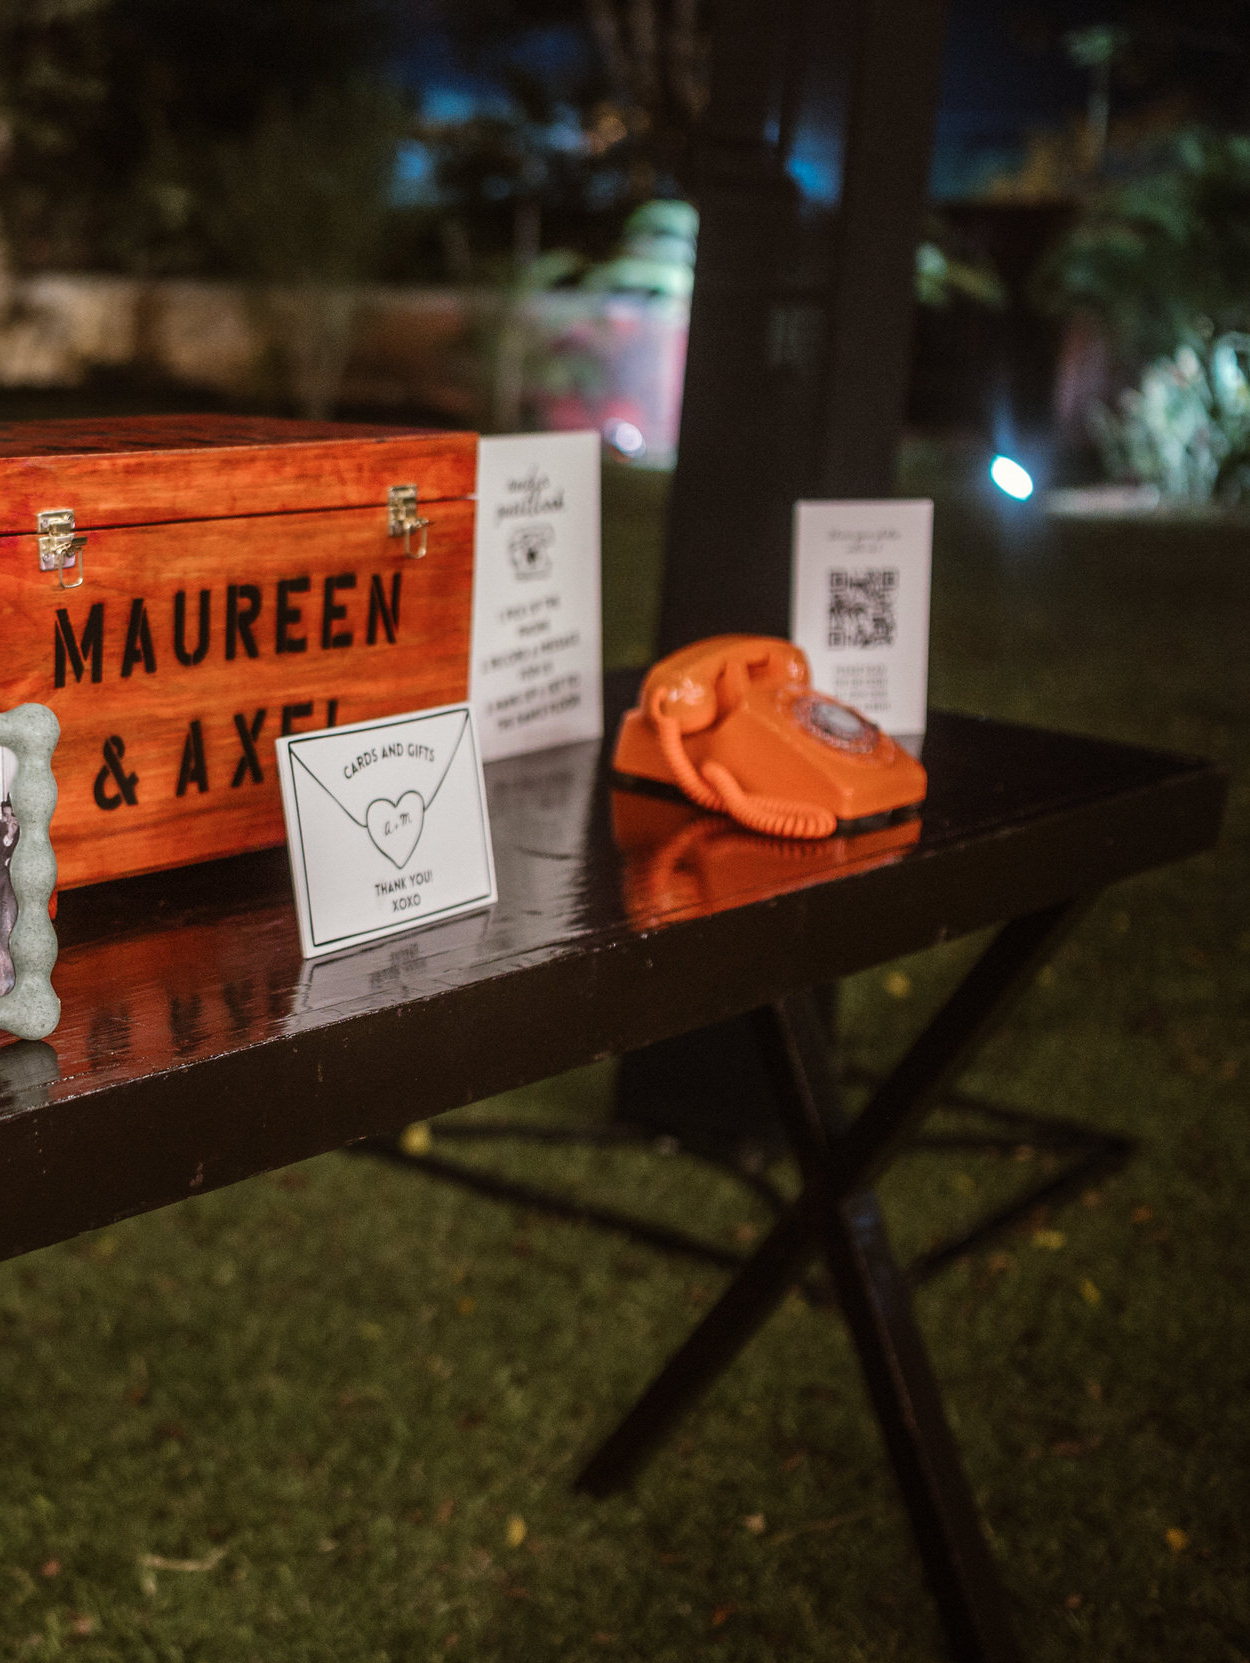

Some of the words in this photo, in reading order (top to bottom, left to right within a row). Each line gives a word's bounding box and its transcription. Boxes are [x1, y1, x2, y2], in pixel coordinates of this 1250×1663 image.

[54, 571, 402, 690] MAUREEN
[93, 734, 140, 811] &
[343, 748, 379, 780] CARDS
[381, 742, 405, 760] AND
[407, 743, 436, 763] GIFTS
[375, 879, 407, 897] THANK
[409, 870, 433, 886] YOU!
[392, 894, 421, 912] XOXO
